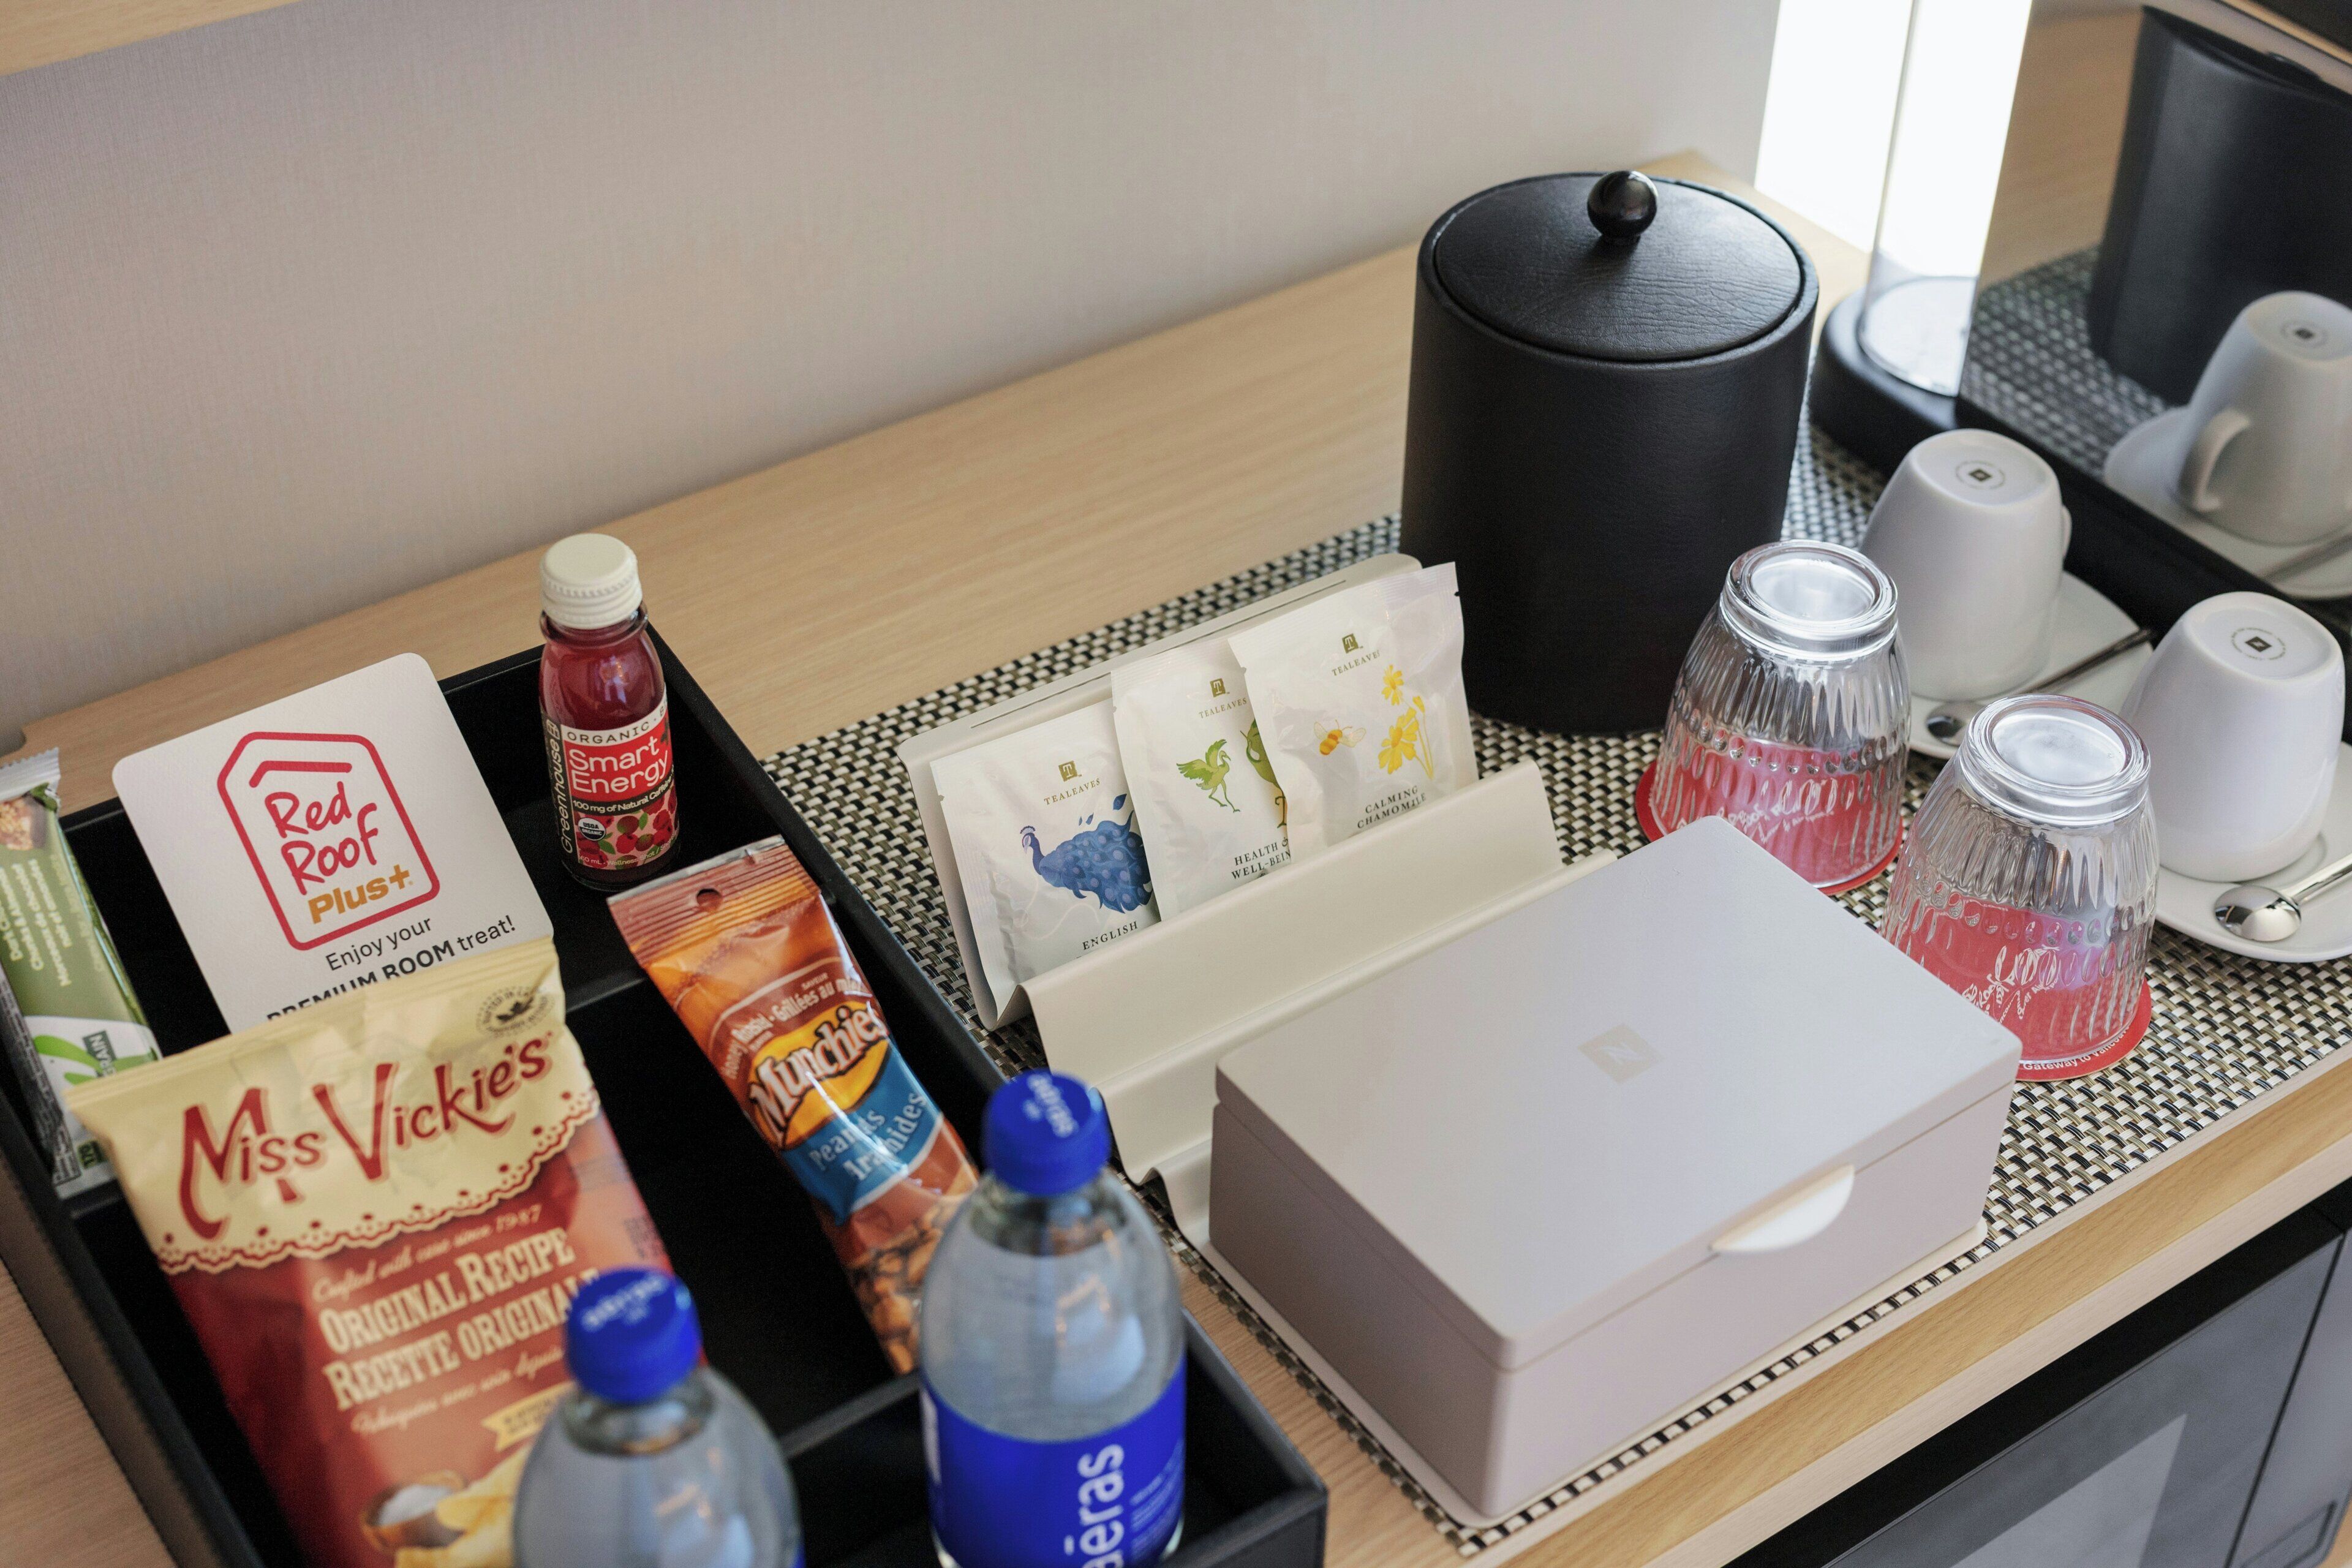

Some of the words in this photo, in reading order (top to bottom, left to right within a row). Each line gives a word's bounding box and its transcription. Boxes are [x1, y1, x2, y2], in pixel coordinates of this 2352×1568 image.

[1331, 649, 1381, 676] TEALEAVES
[1198, 697, 1248, 719] TEALEAVES
[567, 722, 650, 744] ORGANIC
[568, 736, 660, 772] Smart
[571, 750, 668, 794] Energy
[549, 739, 573, 854] Greenhouse
[573, 800, 589, 810] 100
[606, 804, 617, 813] of
[617, 796, 649, 812] Natural
[1043, 778, 1101, 805] TEALEAVES
[1365, 785, 1418, 813] CALMING
[264, 781, 352, 839] Red
[582, 821, 600, 830] USDA
[1357, 792, 1427, 829] CHAMOMILE
[281, 802, 379, 895] Roof
[1231, 851, 1291, 880] WELL-BEIN
[1234, 842, 1278, 867] HEALTH
[325, 938, 383, 971] Enjoy
[385, 918, 433, 949] your
[382, 940, 456, 980] ROOM
[456, 914, 516, 951] treat!
[1082, 921, 1138, 950] ENGLISH
[771, 989, 820, 1022] Grillées
[818, 981, 835, 1000] au
[2022, 1058, 2078, 1071] Gateway
[2079, 1055, 2091, 1063] to
[312, 1038, 553, 1182] Vickie's
[179, 1087, 326, 1241] Miss
[318, 1271, 467, 1354] ORIGINAL
[454, 1226, 576, 1304] RECIPE
[322, 1330, 462, 1412] RECETTE
